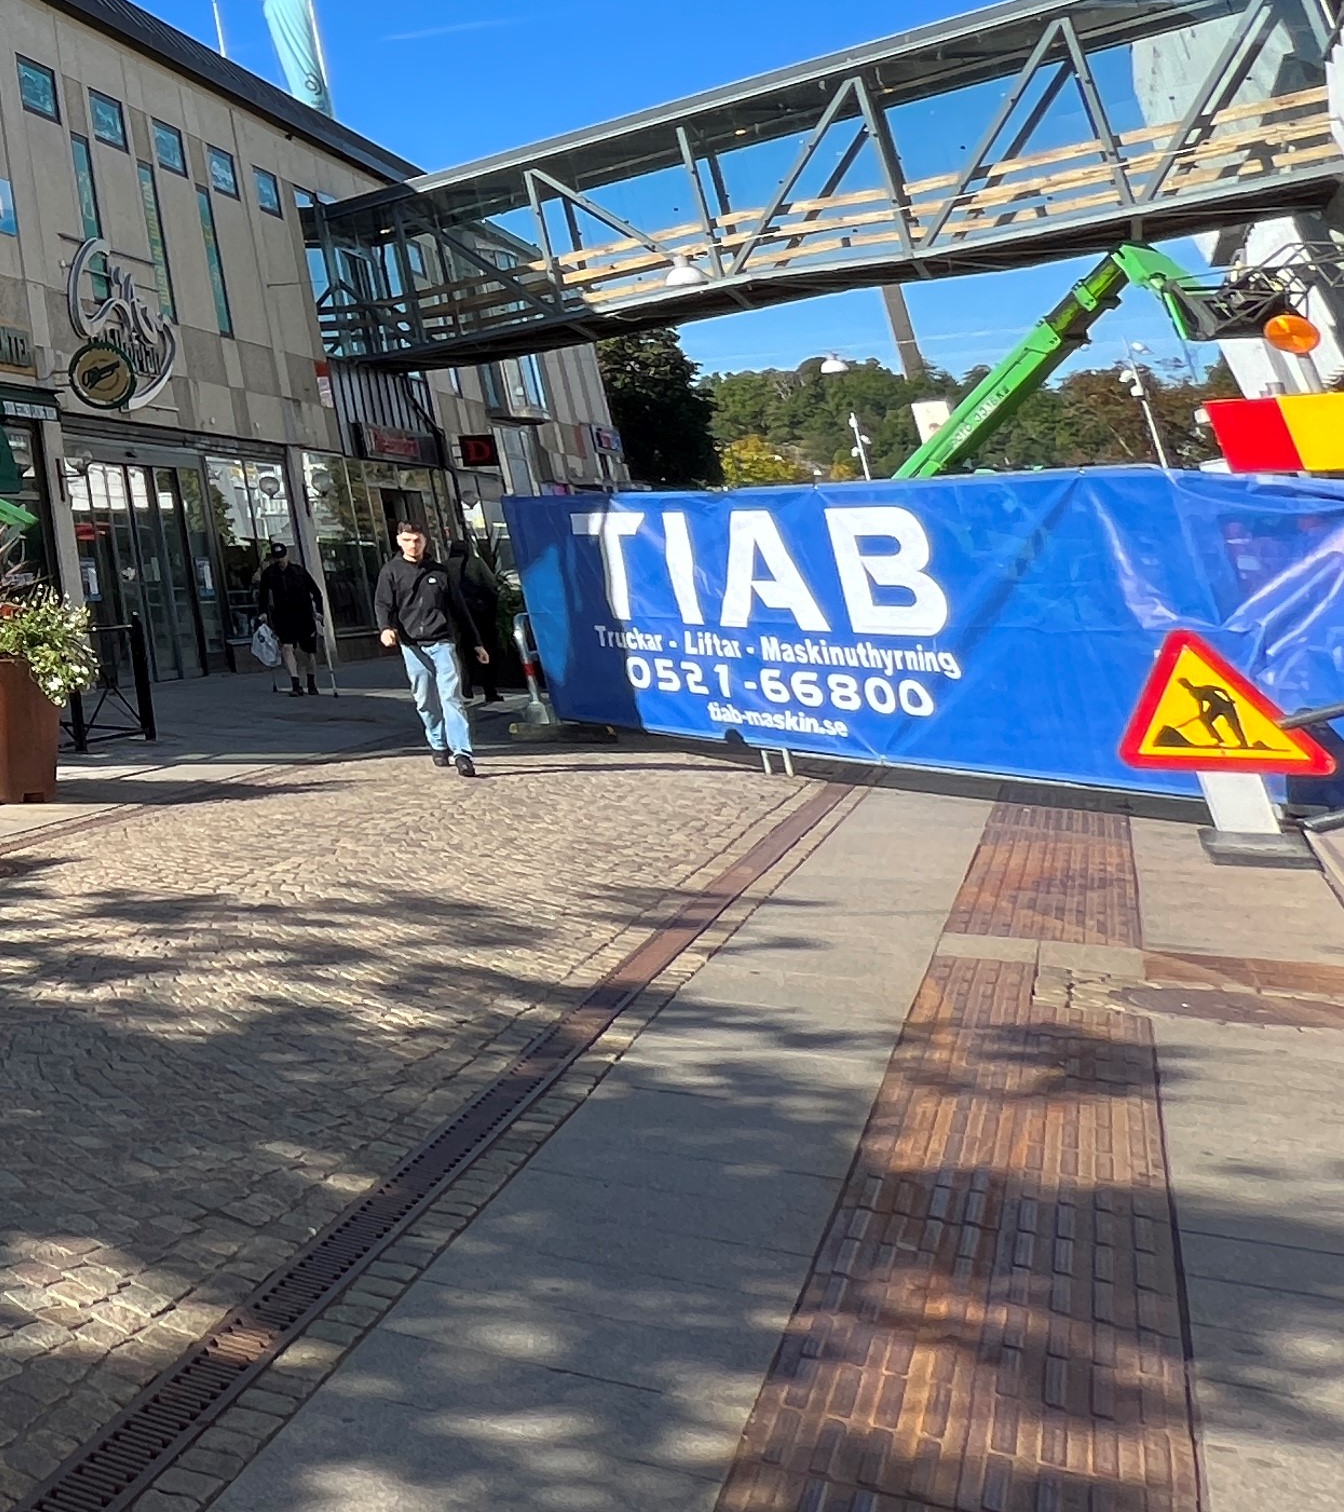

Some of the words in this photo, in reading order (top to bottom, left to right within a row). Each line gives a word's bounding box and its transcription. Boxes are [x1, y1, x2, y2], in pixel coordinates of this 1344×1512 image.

[466, 441, 491, 462] D
[569, 505, 949, 637] TIAB
[593, 625, 663, 652] Truckar
[684, 630, 742, 659] Liftar
[760, 636, 963, 681] Maskinuthyrning
[625, 656, 936, 718] 0521-66800
[707, 700, 849, 739] tiab-maskin.se
